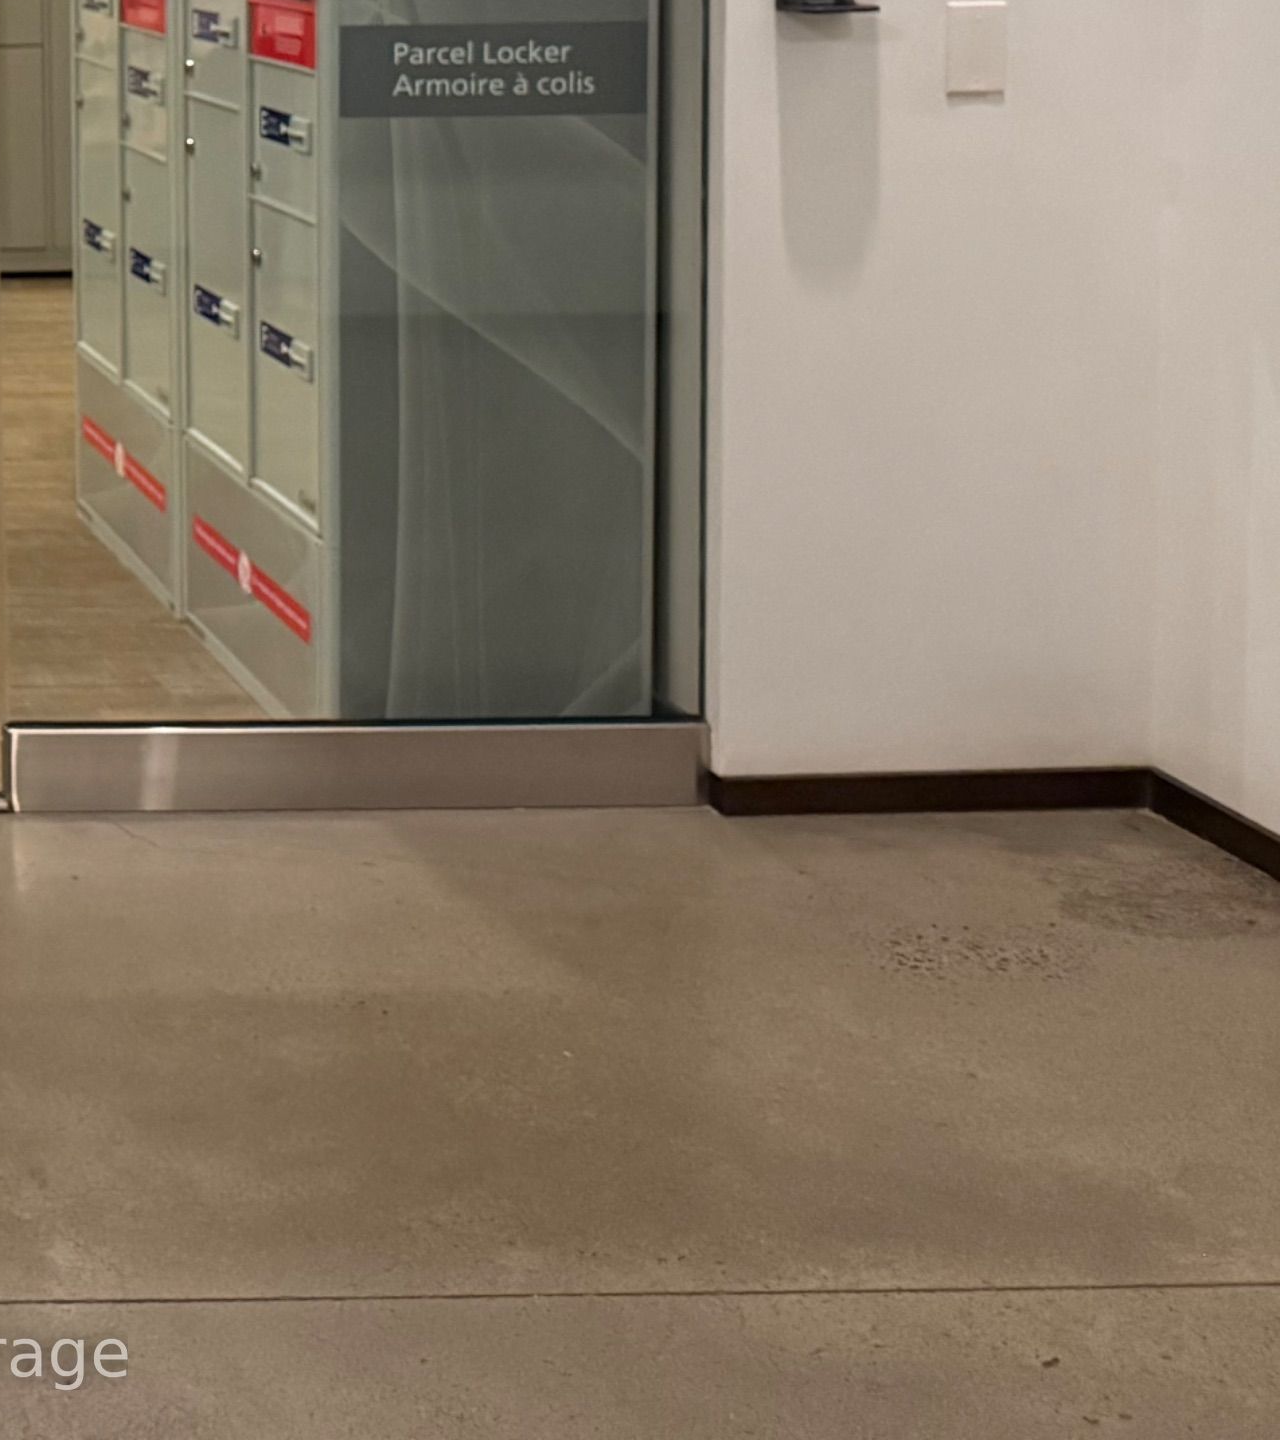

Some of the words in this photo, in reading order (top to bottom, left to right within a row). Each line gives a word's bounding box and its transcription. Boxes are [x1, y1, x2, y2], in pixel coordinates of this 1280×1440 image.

[393, 40, 474, 65] Parcel
[483, 39, 572, 64] Locker
[392, 72, 505, 97] Armoire
[512, 72, 529, 96] à
[536, 70, 596, 95] colis
